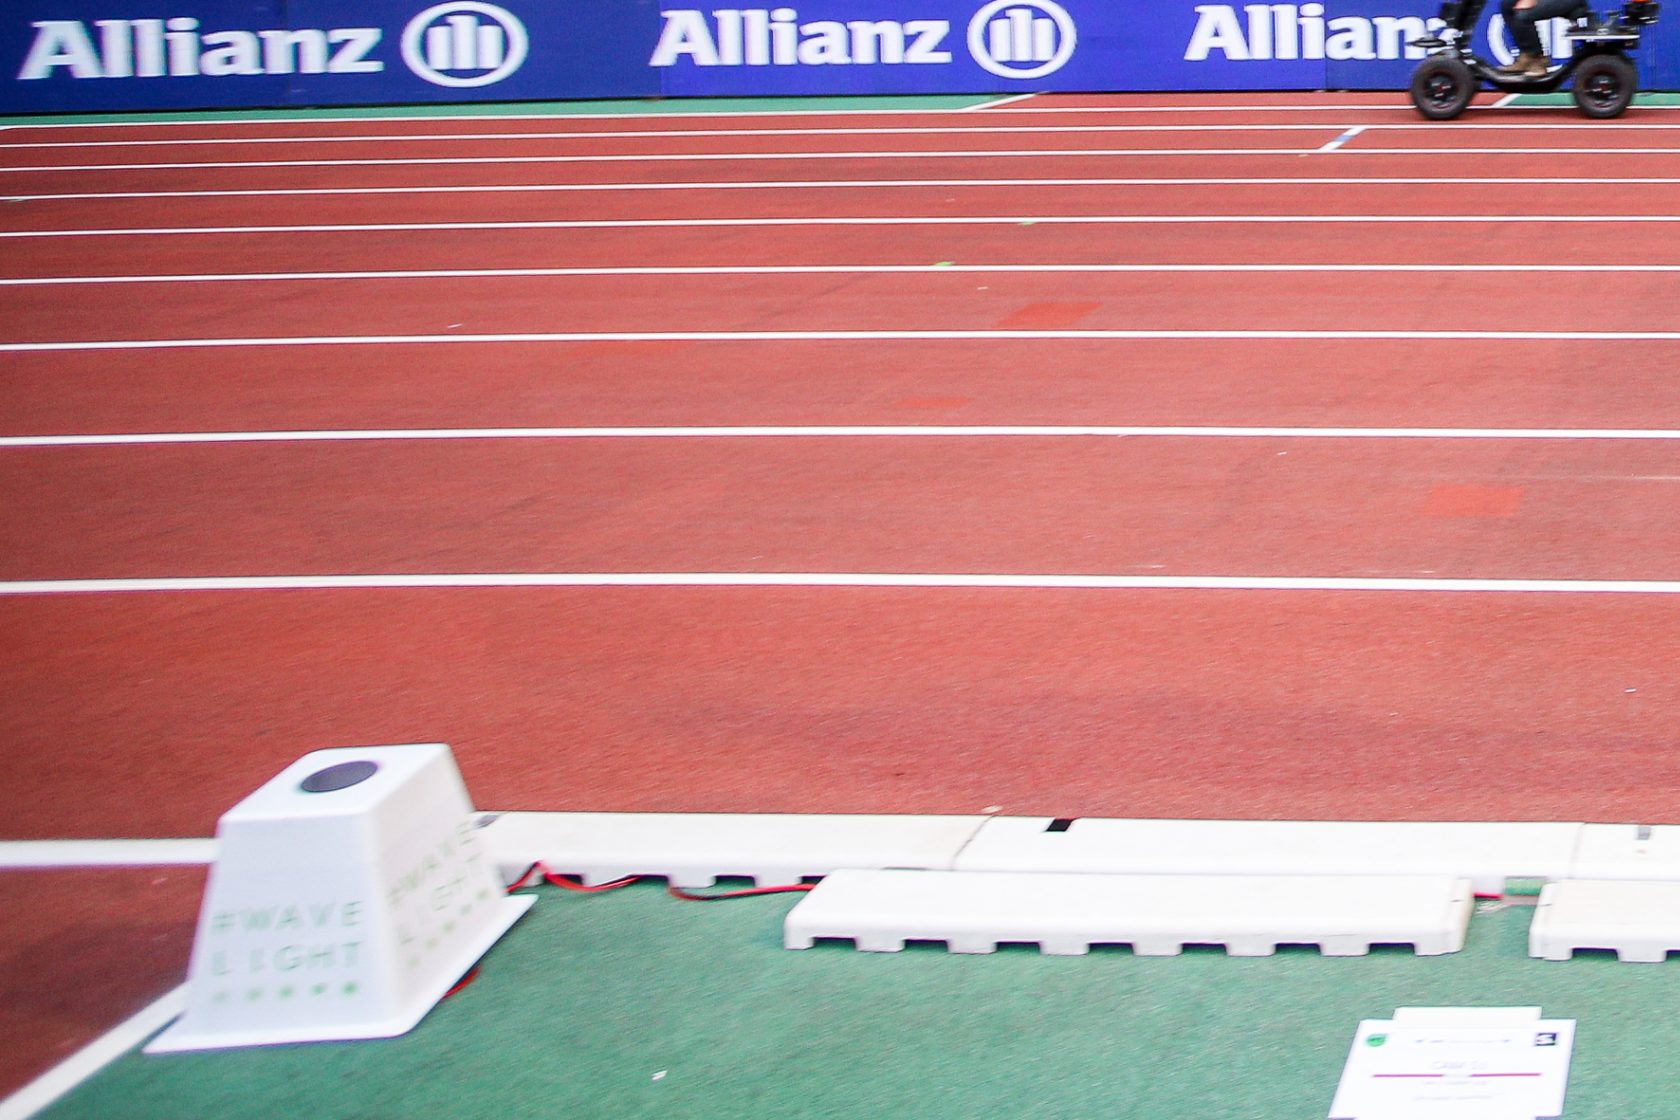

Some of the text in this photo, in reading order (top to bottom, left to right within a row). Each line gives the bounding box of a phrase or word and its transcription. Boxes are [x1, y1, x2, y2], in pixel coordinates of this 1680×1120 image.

[20, 18, 383, 80] Allianz
[649, 8, 952, 67] Allianz
[210, 940, 361, 977] LIGHT
